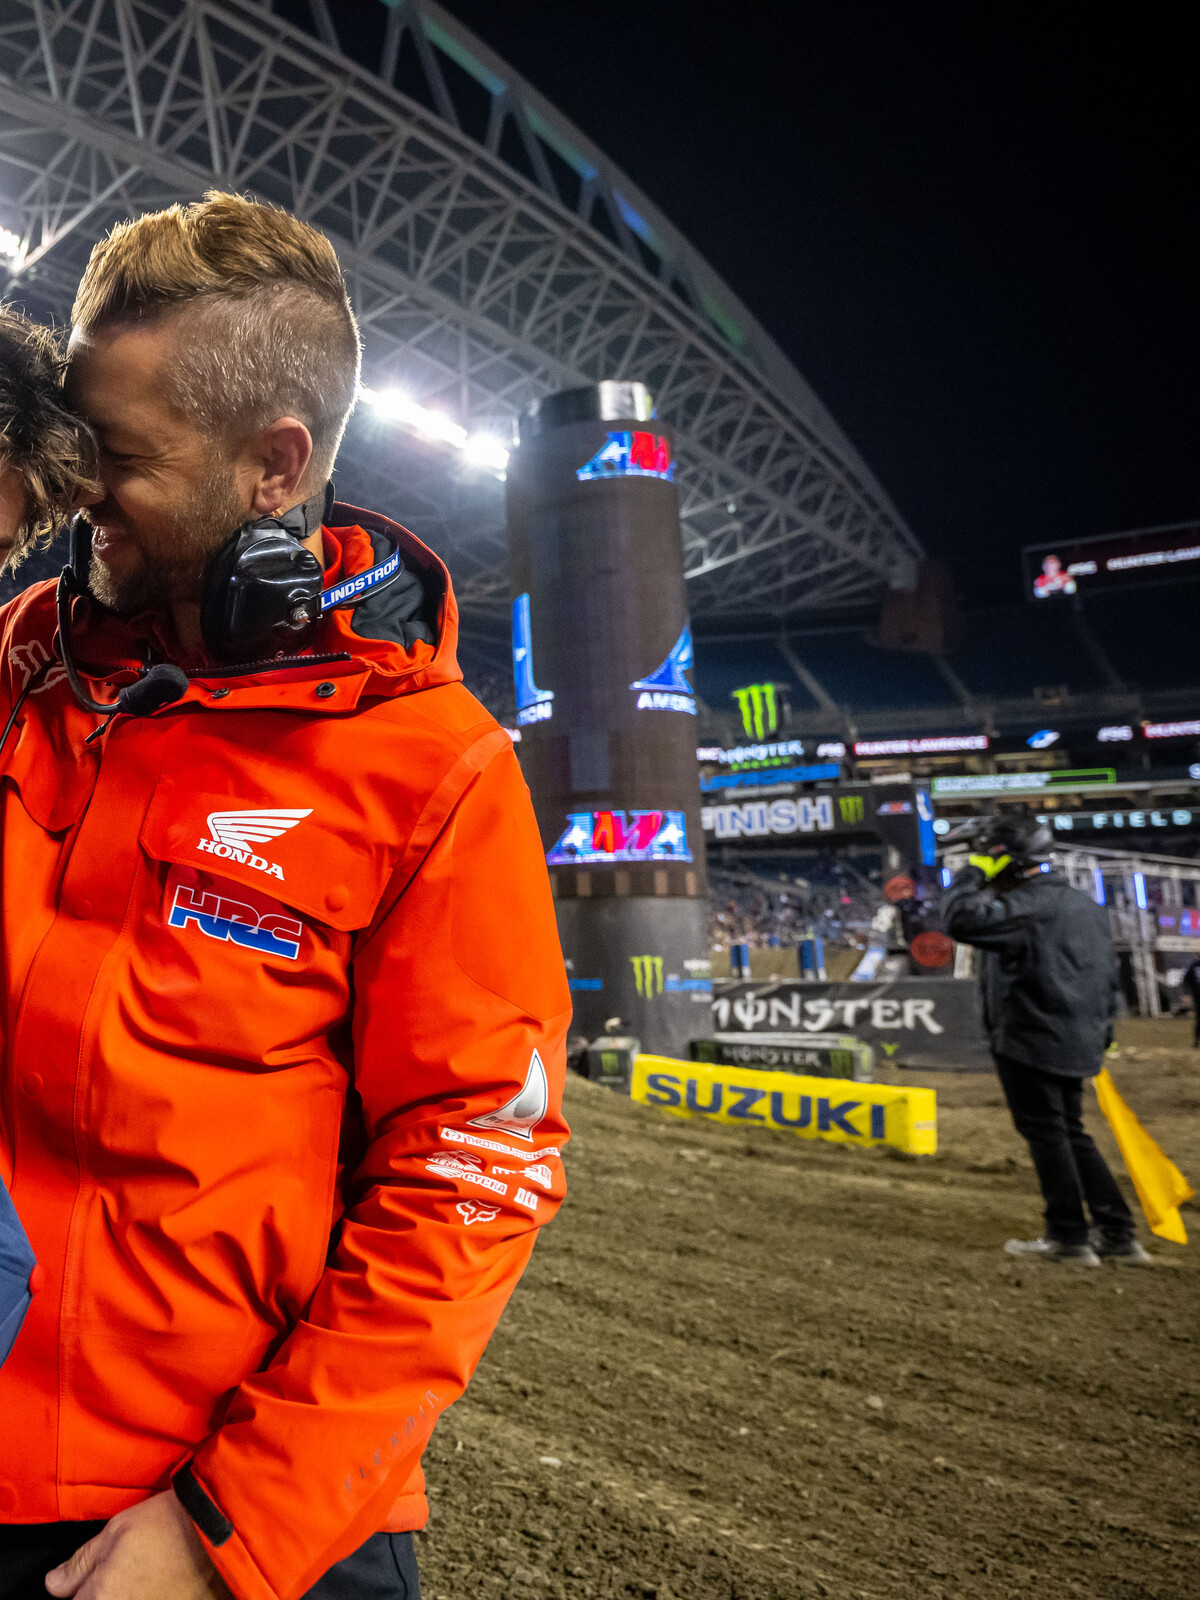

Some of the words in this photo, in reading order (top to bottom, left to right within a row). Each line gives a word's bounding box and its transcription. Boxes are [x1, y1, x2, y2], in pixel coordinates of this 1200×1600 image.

[196, 837, 286, 881] HONDA
[168, 884, 303, 960] HRC
[645, 1072, 886, 1140] SUZUKI
[463, 1172, 507, 1195] CYCRA
